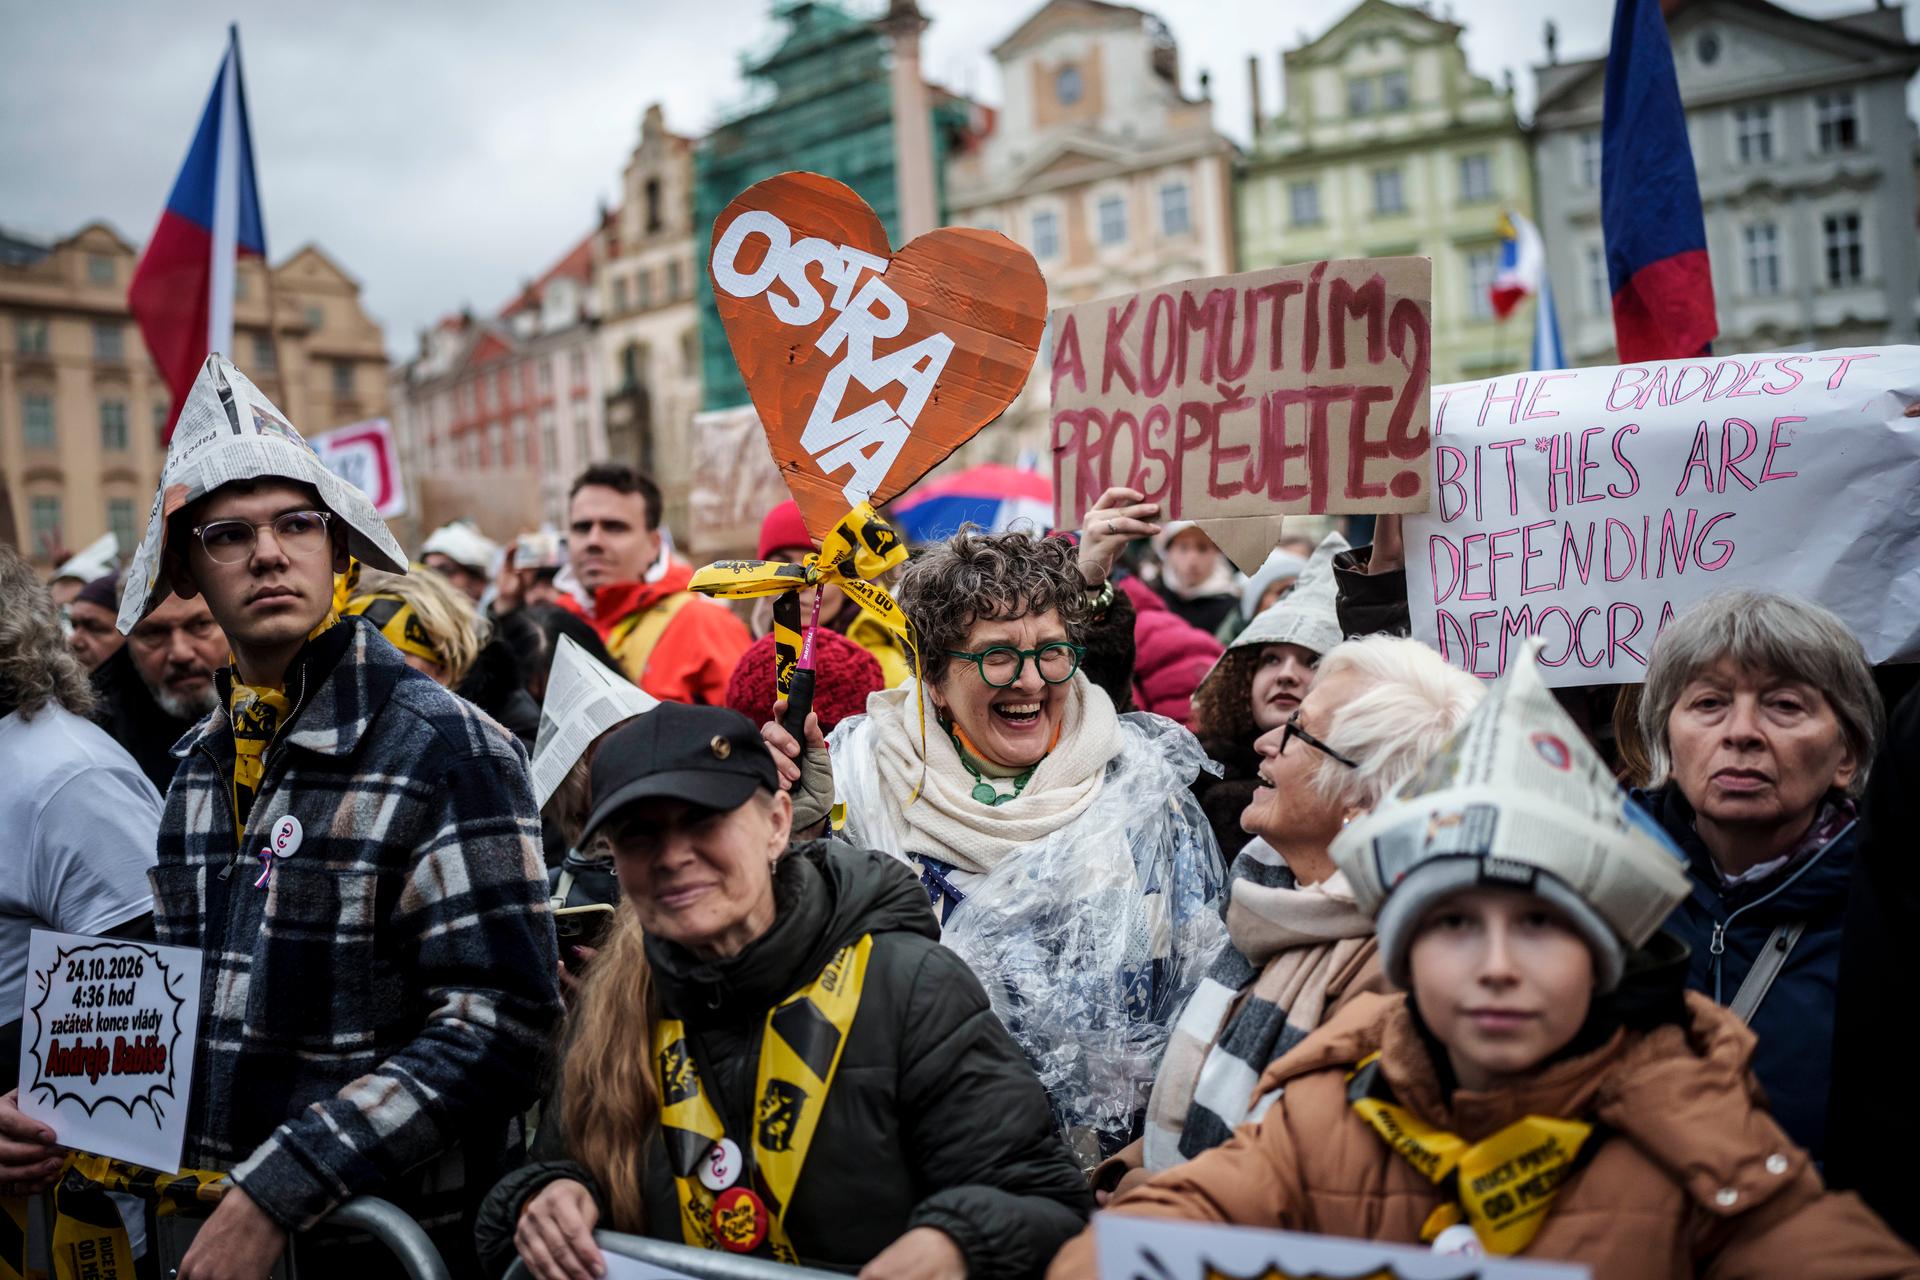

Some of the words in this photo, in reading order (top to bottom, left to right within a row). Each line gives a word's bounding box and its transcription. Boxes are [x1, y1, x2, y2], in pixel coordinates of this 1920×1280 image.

[1051, 314, 1086, 400] A
[1431, 374, 1578, 436] THE
[1606, 353, 1880, 412] BADDEST
[1676, 416, 1807, 497] ARE
[1430, 508, 1737, 604] DEFENDING
[66, 955, 144, 982] 24.10.2026
[71, 985, 105, 1009] 4:36
[108, 981, 136, 1007] hod
[50, 1012, 94, 1035] začátek
[96, 1010, 129, 1032] konce
[131, 1008, 163, 1035] vlády
[44, 1037, 111, 1085] Andreje
[78, 1239, 97, 1260] OD
